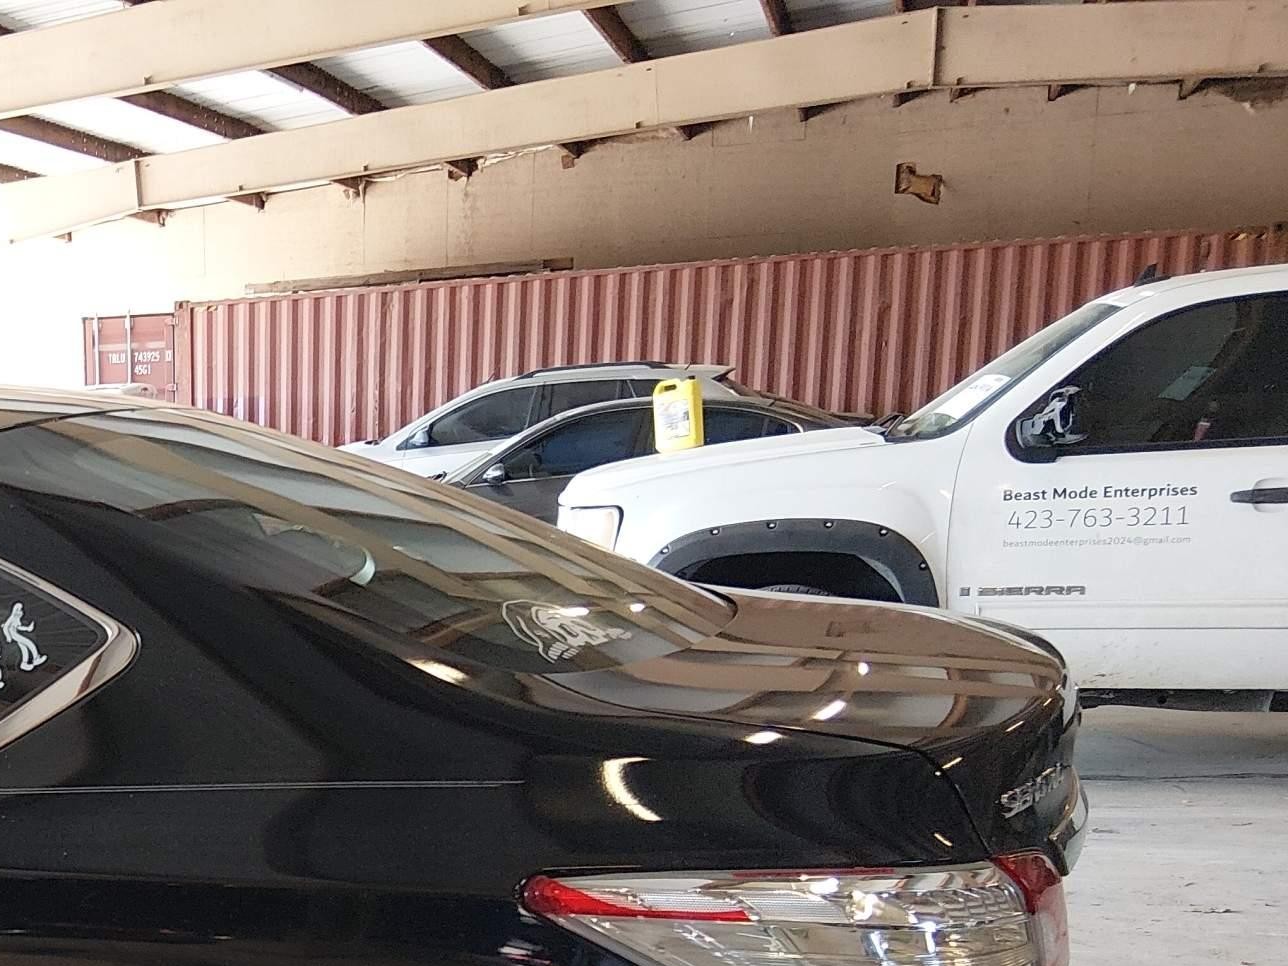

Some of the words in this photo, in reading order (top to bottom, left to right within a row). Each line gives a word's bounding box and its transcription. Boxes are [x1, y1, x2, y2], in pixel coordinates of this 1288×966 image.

[1002, 488, 1048, 502] Beast
[1052, 486, 1099, 500] Mode
[1103, 484, 1199, 500] Enterprises
[1007, 505, 1190, 530] 423-763-3211
[1002, 535, 1192, 549] beastmodeenterprises2024@gmail.com
[977, 585, 1086, 596] SIERRA
